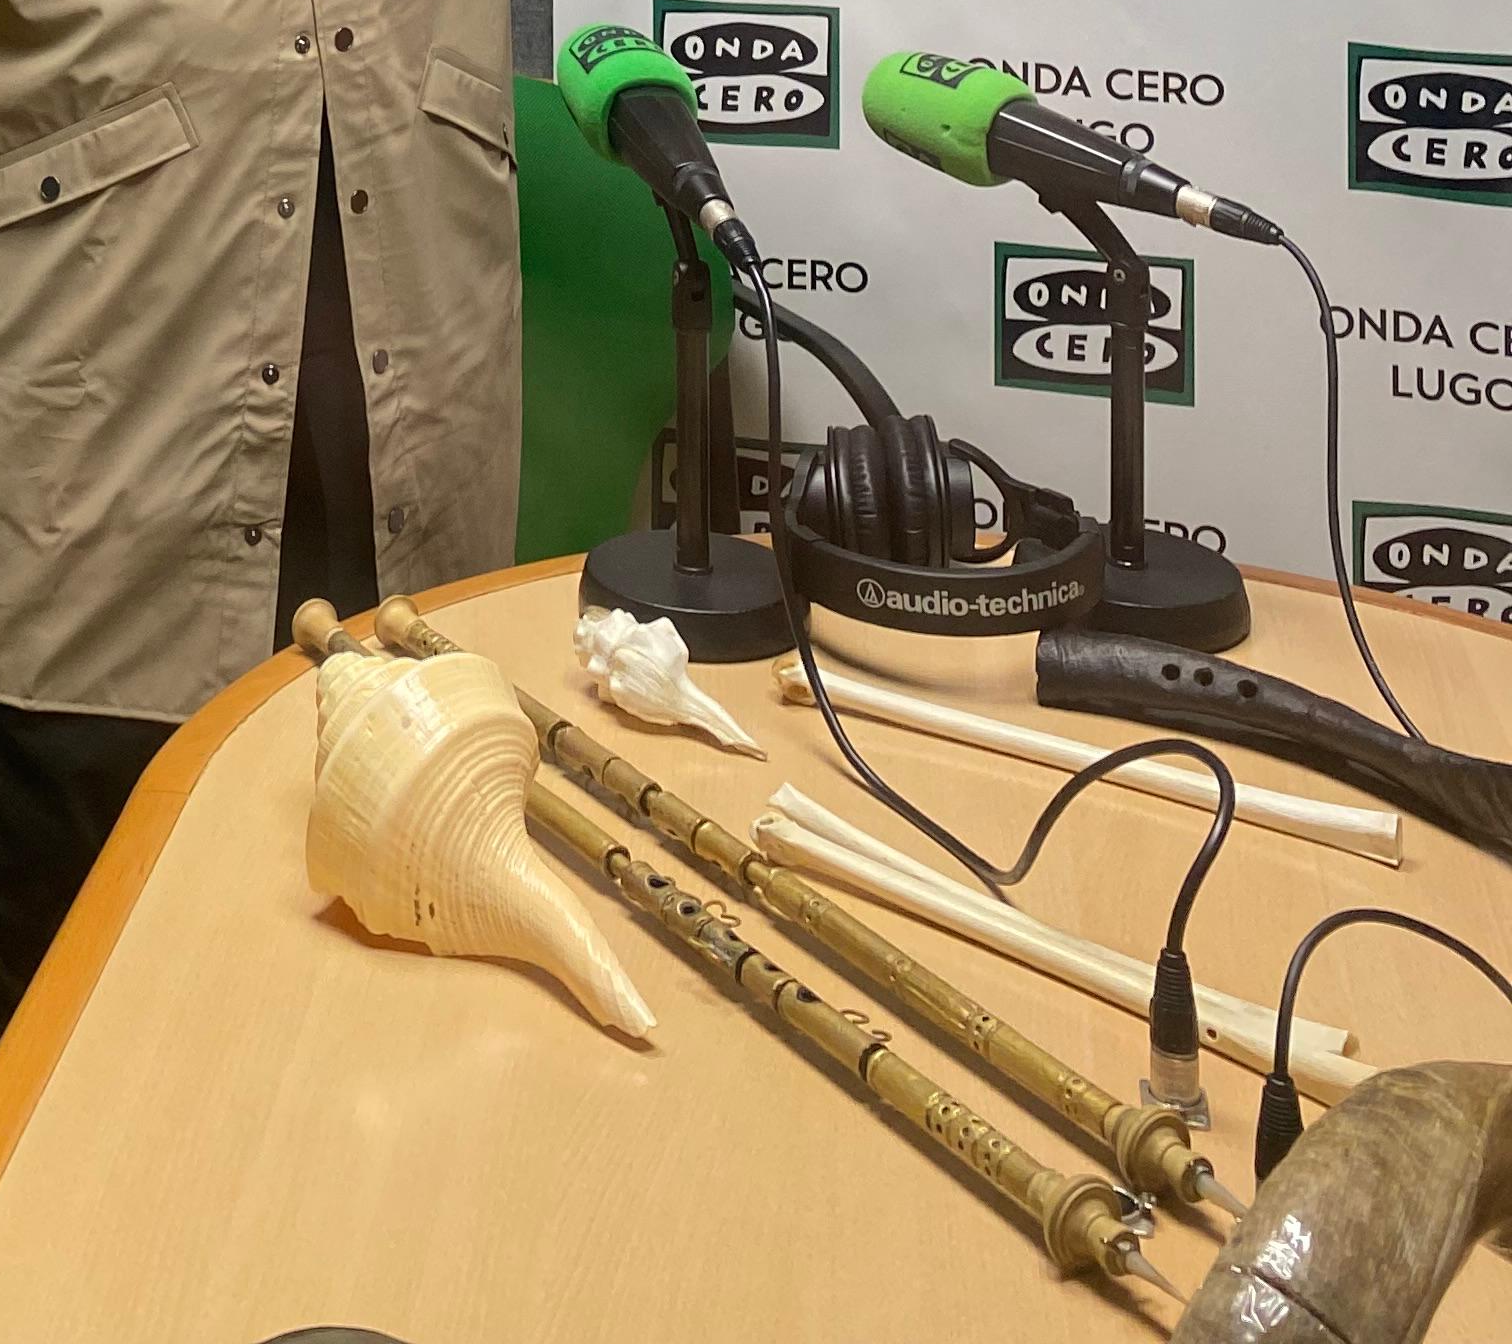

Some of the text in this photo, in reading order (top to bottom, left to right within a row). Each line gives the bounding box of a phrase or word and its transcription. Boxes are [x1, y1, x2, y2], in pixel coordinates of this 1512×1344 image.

[683, 34, 804, 62] ONDA
[694, 83, 805, 113] CERO
[1104, 68, 1225, 107] CERO
[760, 258, 869, 293] CERO
[1319, 305, 1455, 349] ONDA
[886, 579, 1082, 618] audio-technica
